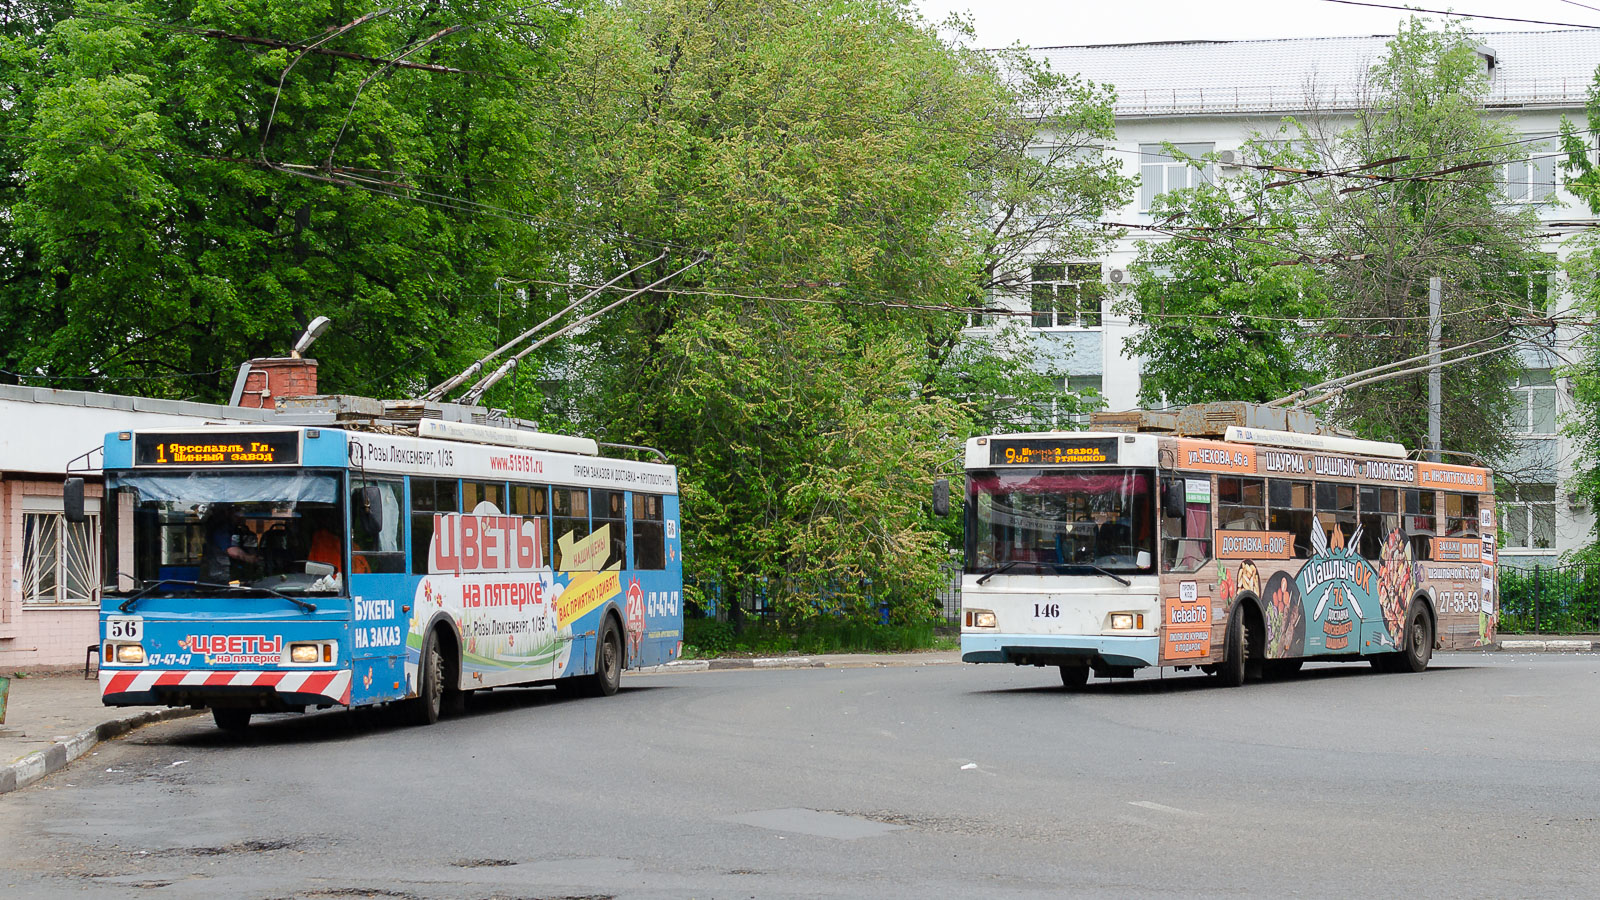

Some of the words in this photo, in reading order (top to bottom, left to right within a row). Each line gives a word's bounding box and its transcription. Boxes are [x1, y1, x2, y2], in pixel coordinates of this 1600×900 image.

[156, 443, 168, 463] 1
[169, 443, 244, 455] Ярославль
[250, 442, 275, 452] Гл.
[173, 452, 224, 462] Шинный
[231, 453, 274, 462] завод
[437, 449, 454, 467] 1/35
[1005, 447, 1016, 464] 9
[1066, 447, 1100, 455] завод
[490, 454, 543, 474] www.515151.ru
[1233, 451, 1243, 466] 46
[1243, 455, 1249, 467] а
[1265, 451, 1305, 474] ШАУРМА
[1314, 455, 1356, 477] ШАШЛЫК
[573, 464, 590, 477] ПРИЕМ
[590, 466, 610, 480] ЗАКАЗОВ
[610, 468, 615, 480] И
[614, 468, 636, 483] ДОСТАВКА
[640, 472, 672, 486] КРУГЛОСУТОЧНО
[1365, 460, 1389, 480] ЛЮЛЯ
[1389, 462, 1414, 483] КЕБАБ
[1422, 471, 1431, 483] ул.
[1431, 469, 1476, 488] ИНСТИТУТСКАЯ,
[1476, 474, 1483, 486] 88
[668, 522, 675, 536] 56
[434, 514, 541, 577] ЦВЕТЫ
[573, 549, 590, 568] НАШИ
[590, 536, 606, 561] ЦЕНЫ
[1222, 536, 1262, 555] ДОСТАВКА
[1439, 541, 1460, 552] ЗАКАЖИ
[1428, 566, 1480, 582] шашлычок76.рф
[462, 584, 481, 608] на
[484, 582, 543, 612] пятерке
[558, 602, 570, 622] ВАС
[570, 588, 596, 612] ПРИЯТНО
[595, 574, 617, 599] УДИВЯТ!
[647, 591, 679, 618] 47-47-47
[1333, 587, 1344, 606] 76
[1439, 591, 1479, 613] 27-53-53
[629, 594, 642, 620] 24
[1033, 603, 1060, 618] 146
[1171, 605, 1207, 623] kebab76
[112, 620, 137, 637] 56
[462, 623, 473, 637] ул.
[531, 616, 546, 634] 1/35
[191, 635, 282, 655] ЦВЕТЫ
[355, 627, 369, 649] НА
[370, 625, 401, 648] ЗАКАЗ
[1169, 633, 1183, 642] ЛЮЛЯ
[1183, 632, 1190, 641] ИЗ
[1190, 631, 1209, 642] КУРИЦЫ
[1179, 642, 1201, 653] ПОДАРОК
[149, 653, 192, 666] 47-47-47
[215, 654, 231, 664] на
[232, 654, 281, 666] пятерке
